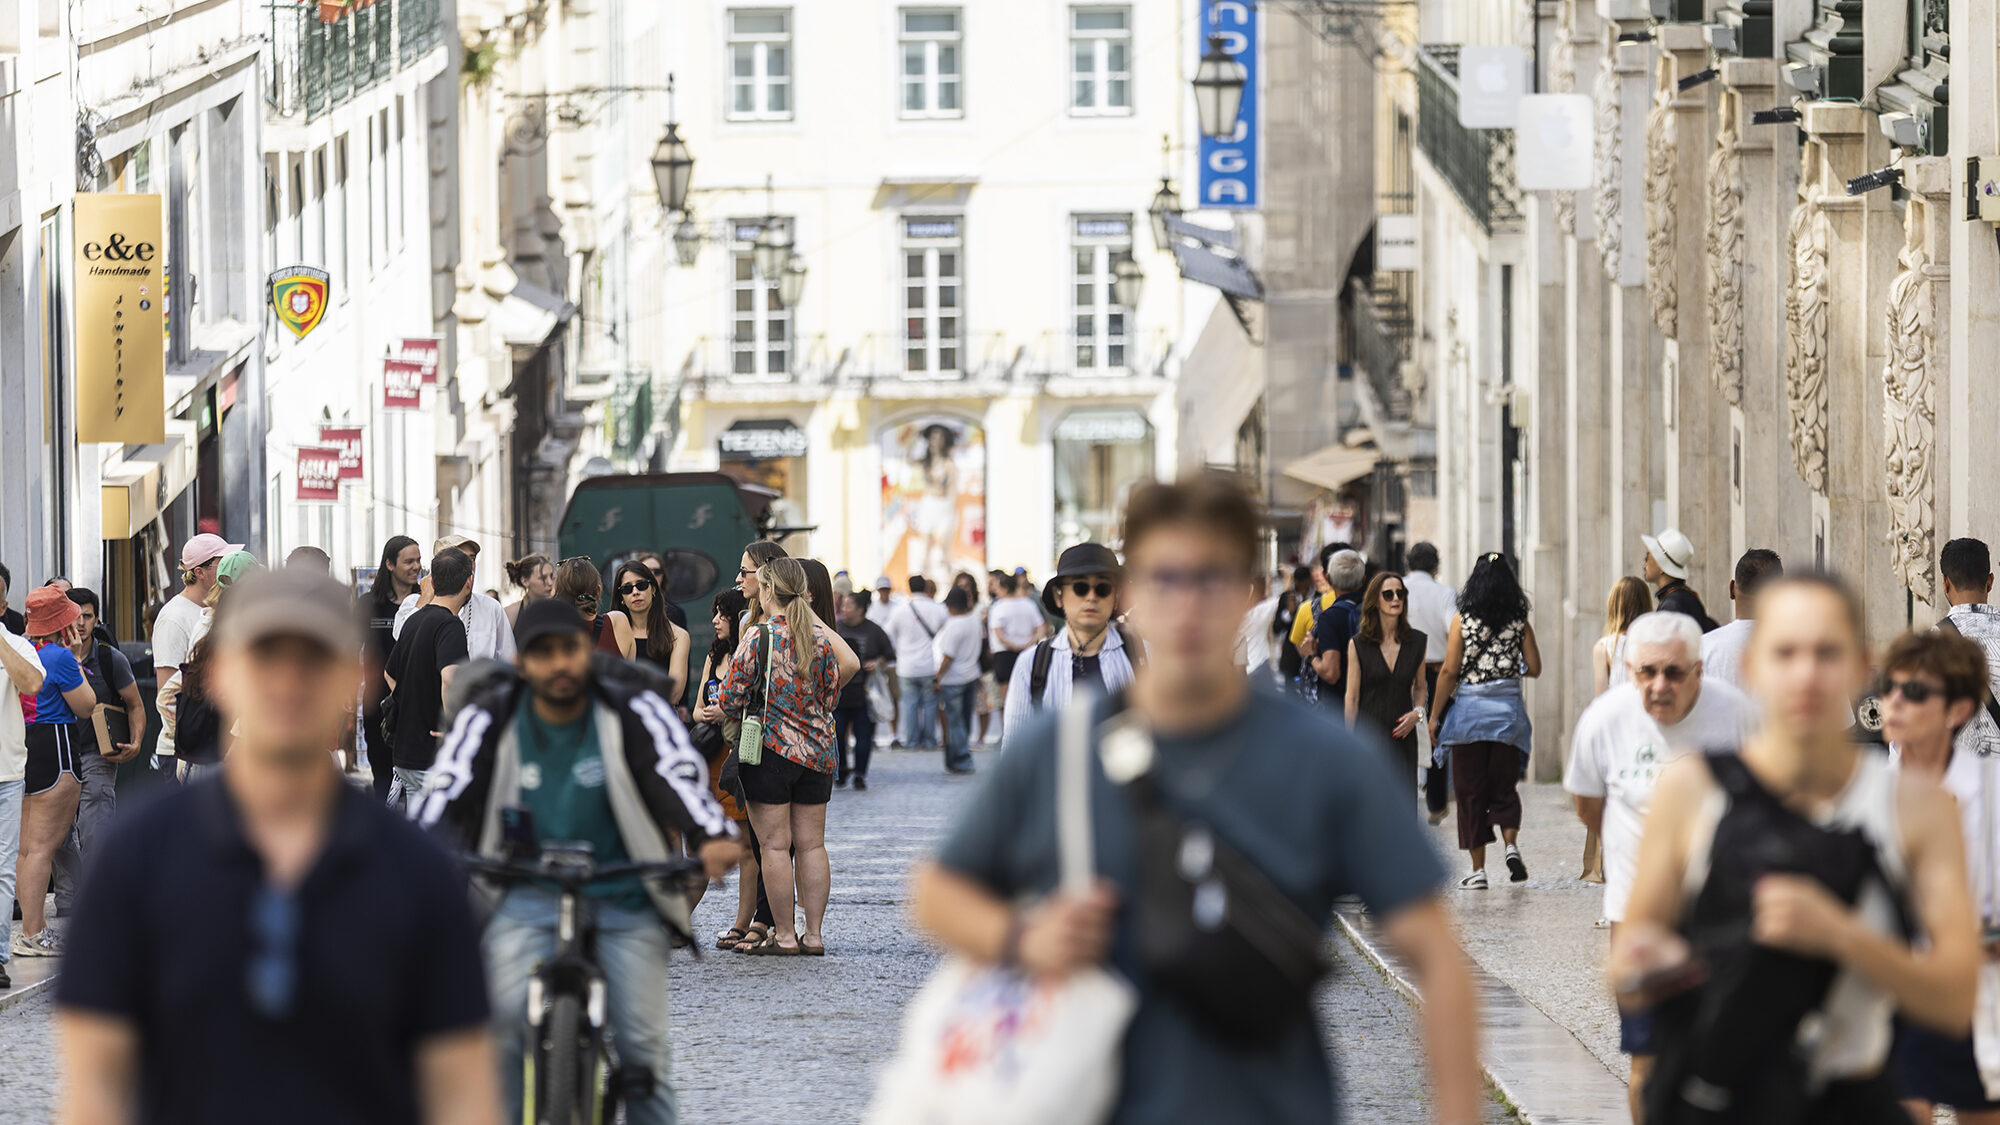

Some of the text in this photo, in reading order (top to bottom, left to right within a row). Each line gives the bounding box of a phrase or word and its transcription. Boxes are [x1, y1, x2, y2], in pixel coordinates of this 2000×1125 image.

[83, 233, 155, 261] e&e
[89, 266, 151, 276] Handmade
[293, 266, 328, 282] PORTUGAL
[114, 294, 124, 417] Jewellery
